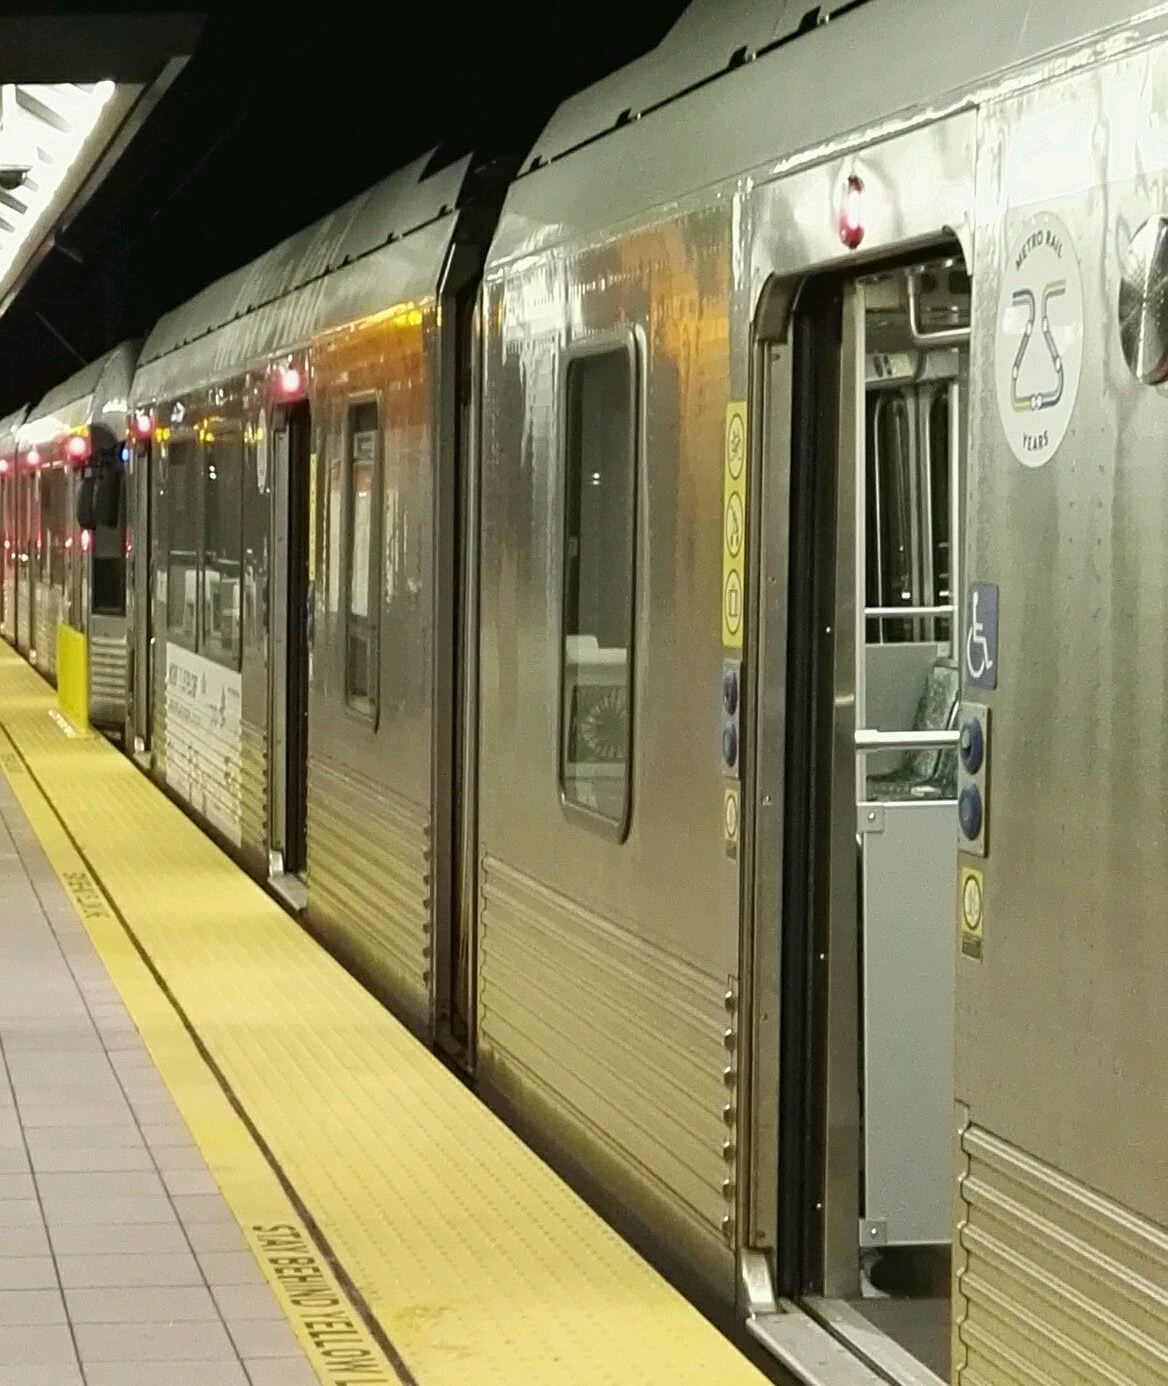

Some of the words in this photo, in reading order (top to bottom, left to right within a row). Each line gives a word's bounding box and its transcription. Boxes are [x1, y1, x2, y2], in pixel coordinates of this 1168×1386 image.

[1015, 229, 1044, 272] METRO
[1045, 229, 1063, 259] RAIL
[1023, 430, 1049, 451] YEARS
[252, 1224, 310, 1253] STAY
[268, 1257, 340, 1308] BEHIND
[299, 1310, 384, 1374] YELLOW
